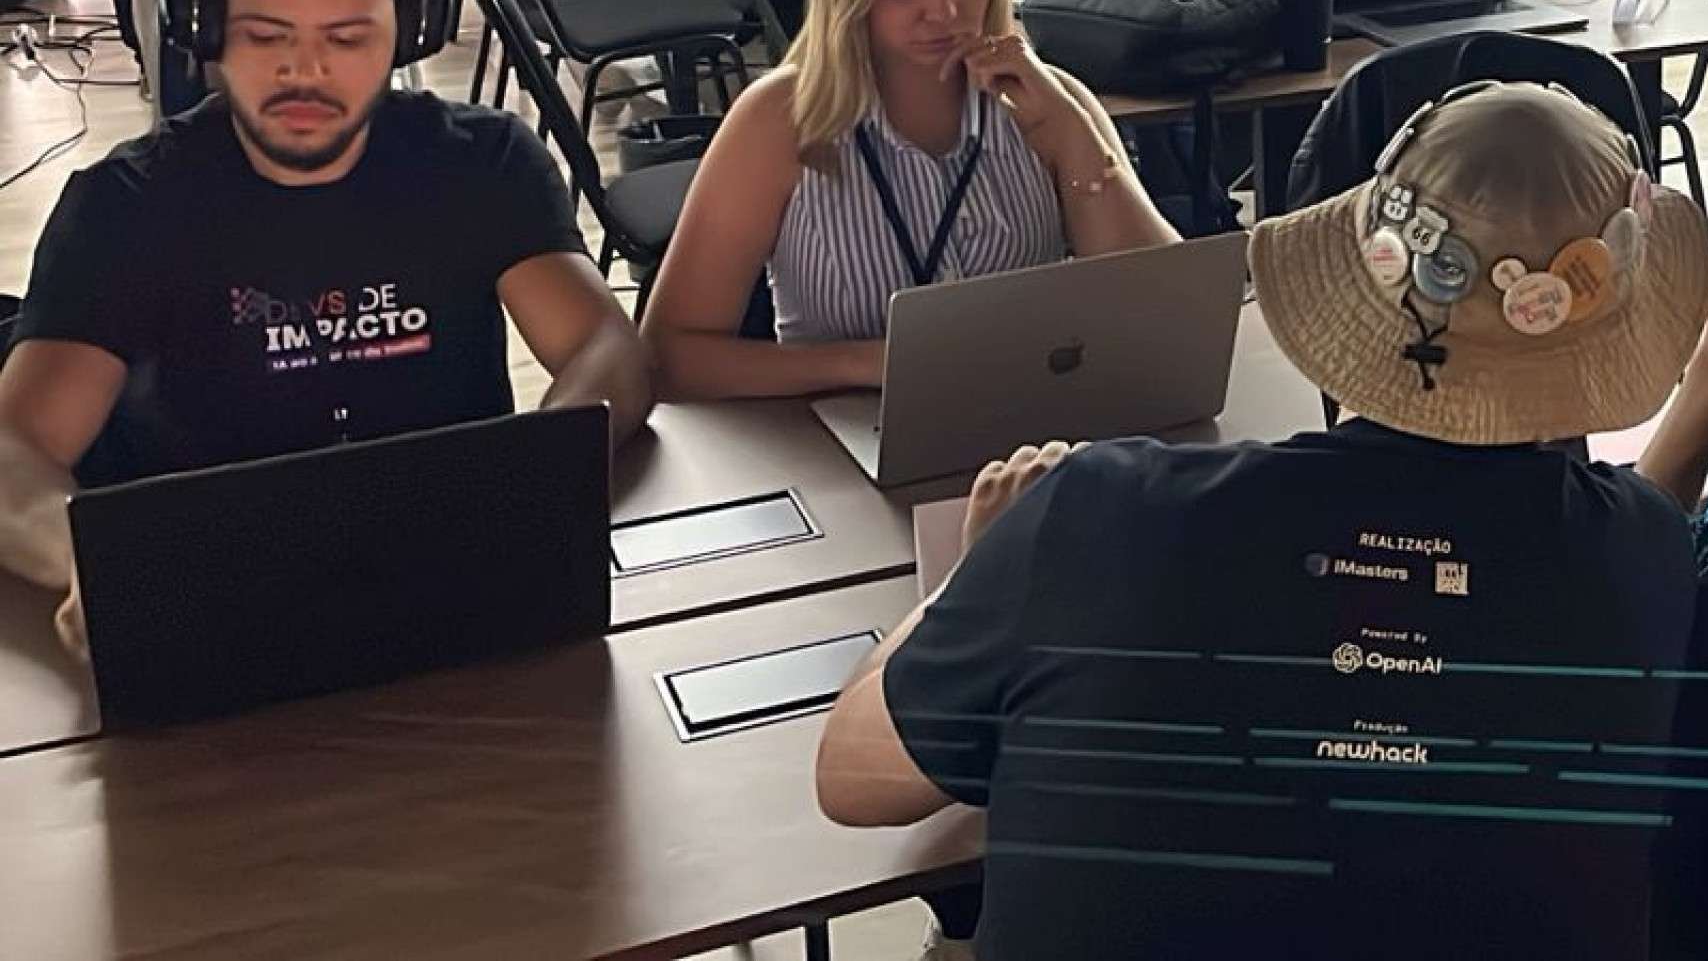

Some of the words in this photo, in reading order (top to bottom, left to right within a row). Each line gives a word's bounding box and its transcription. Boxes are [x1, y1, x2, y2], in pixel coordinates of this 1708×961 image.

[265, 290, 347, 323] DVS
[358, 283, 399, 312] DE
[265, 307, 428, 352] IMPACTO
[1358, 533, 1451, 556] REALIZAÇÃO
[1366, 652, 1443, 674] OpenAI
[1317, 740, 1428, 764] newhack
